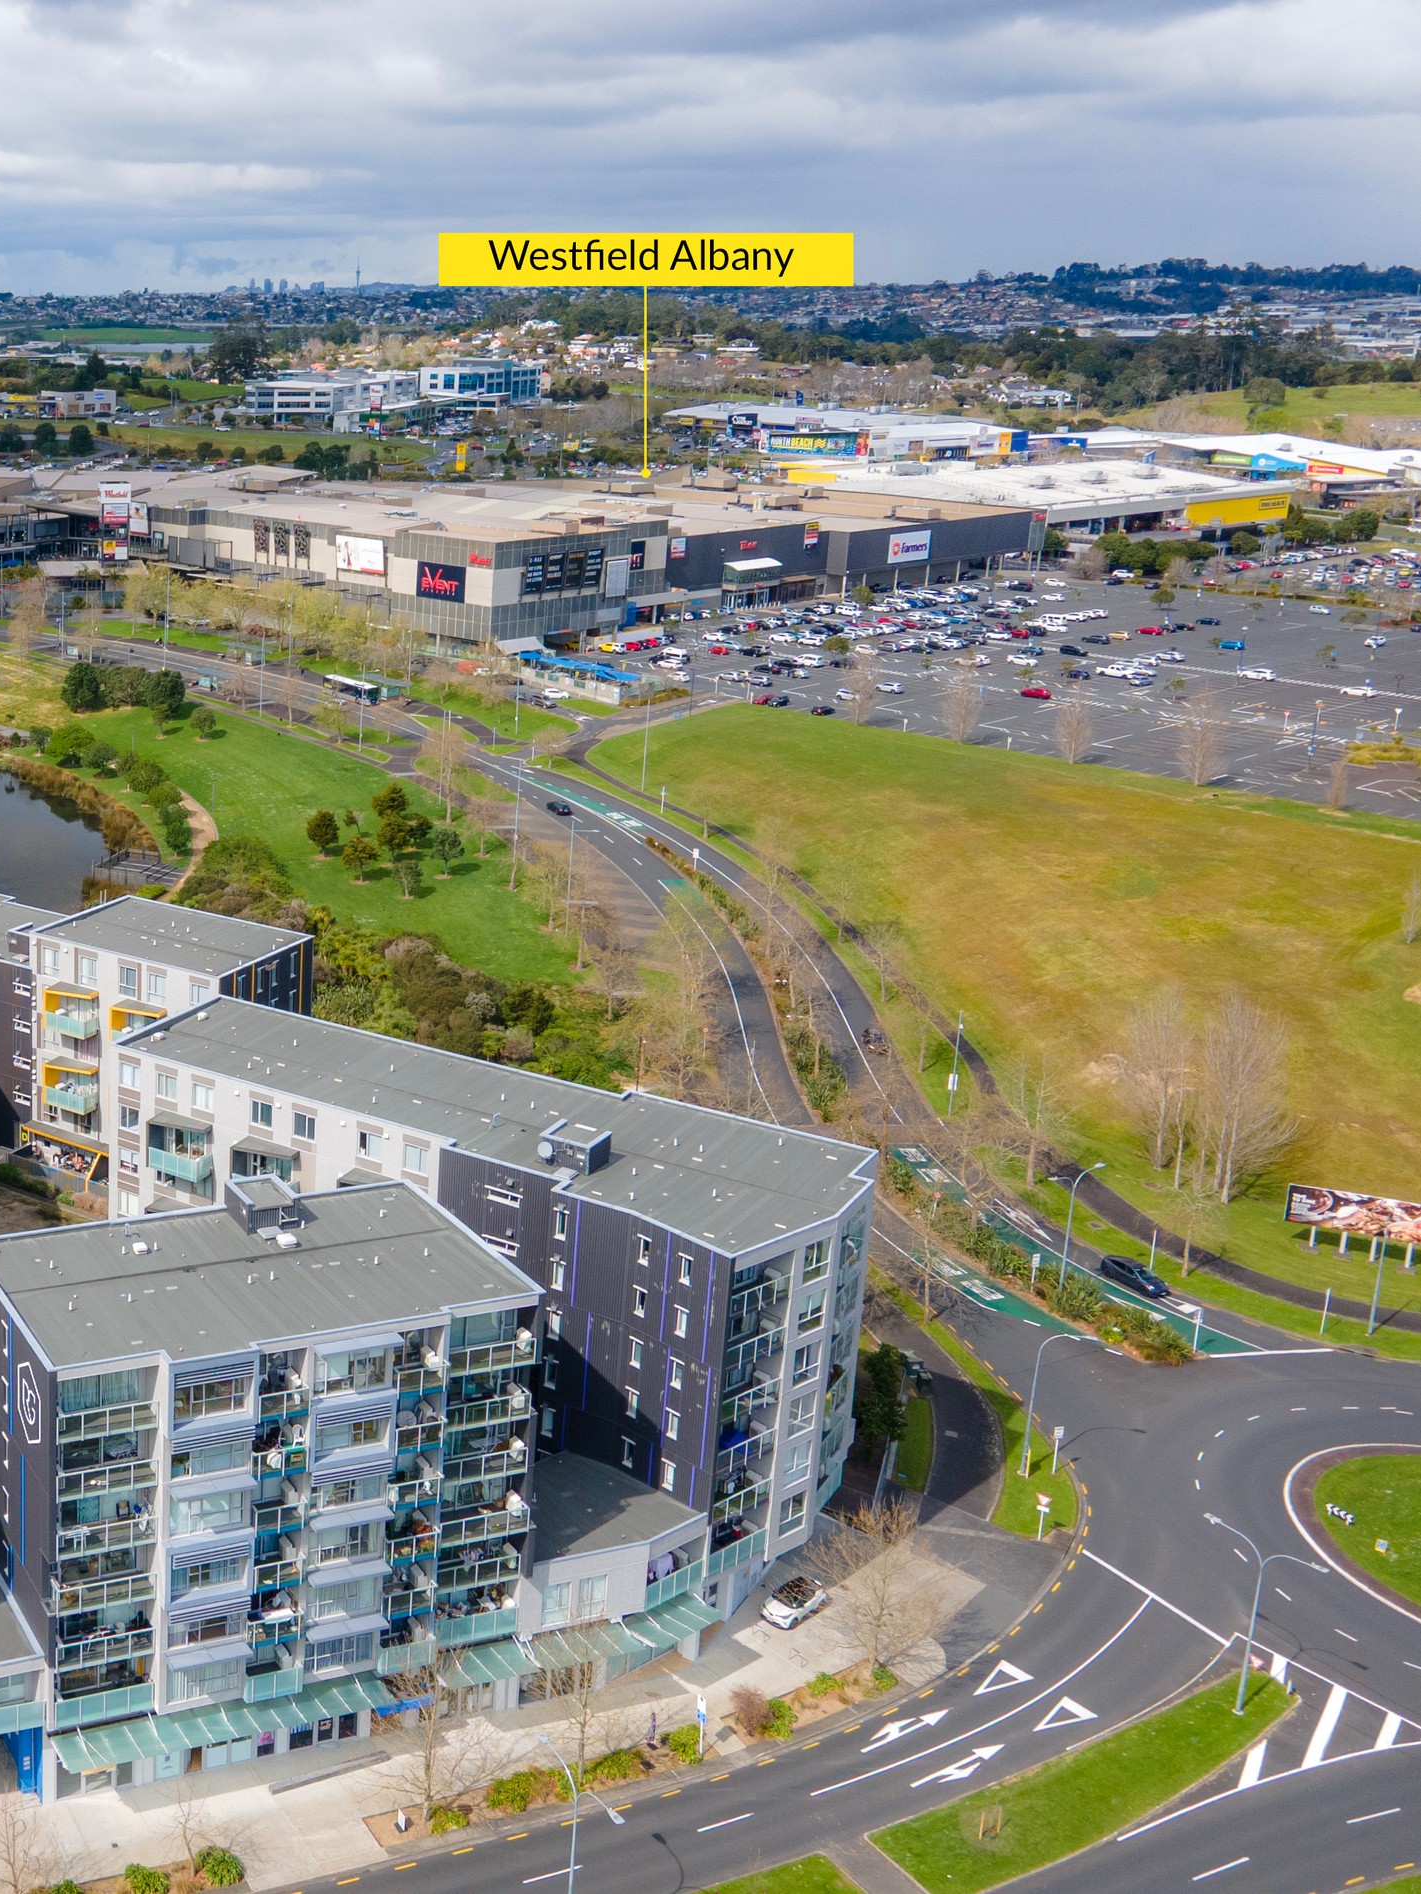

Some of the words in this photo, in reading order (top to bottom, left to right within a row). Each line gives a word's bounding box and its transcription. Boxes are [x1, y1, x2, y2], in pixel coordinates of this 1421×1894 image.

[791, 437, 813, 448] BEACH
[900, 542, 928, 554] Farmers
[421, 566, 459, 592] EVENT
